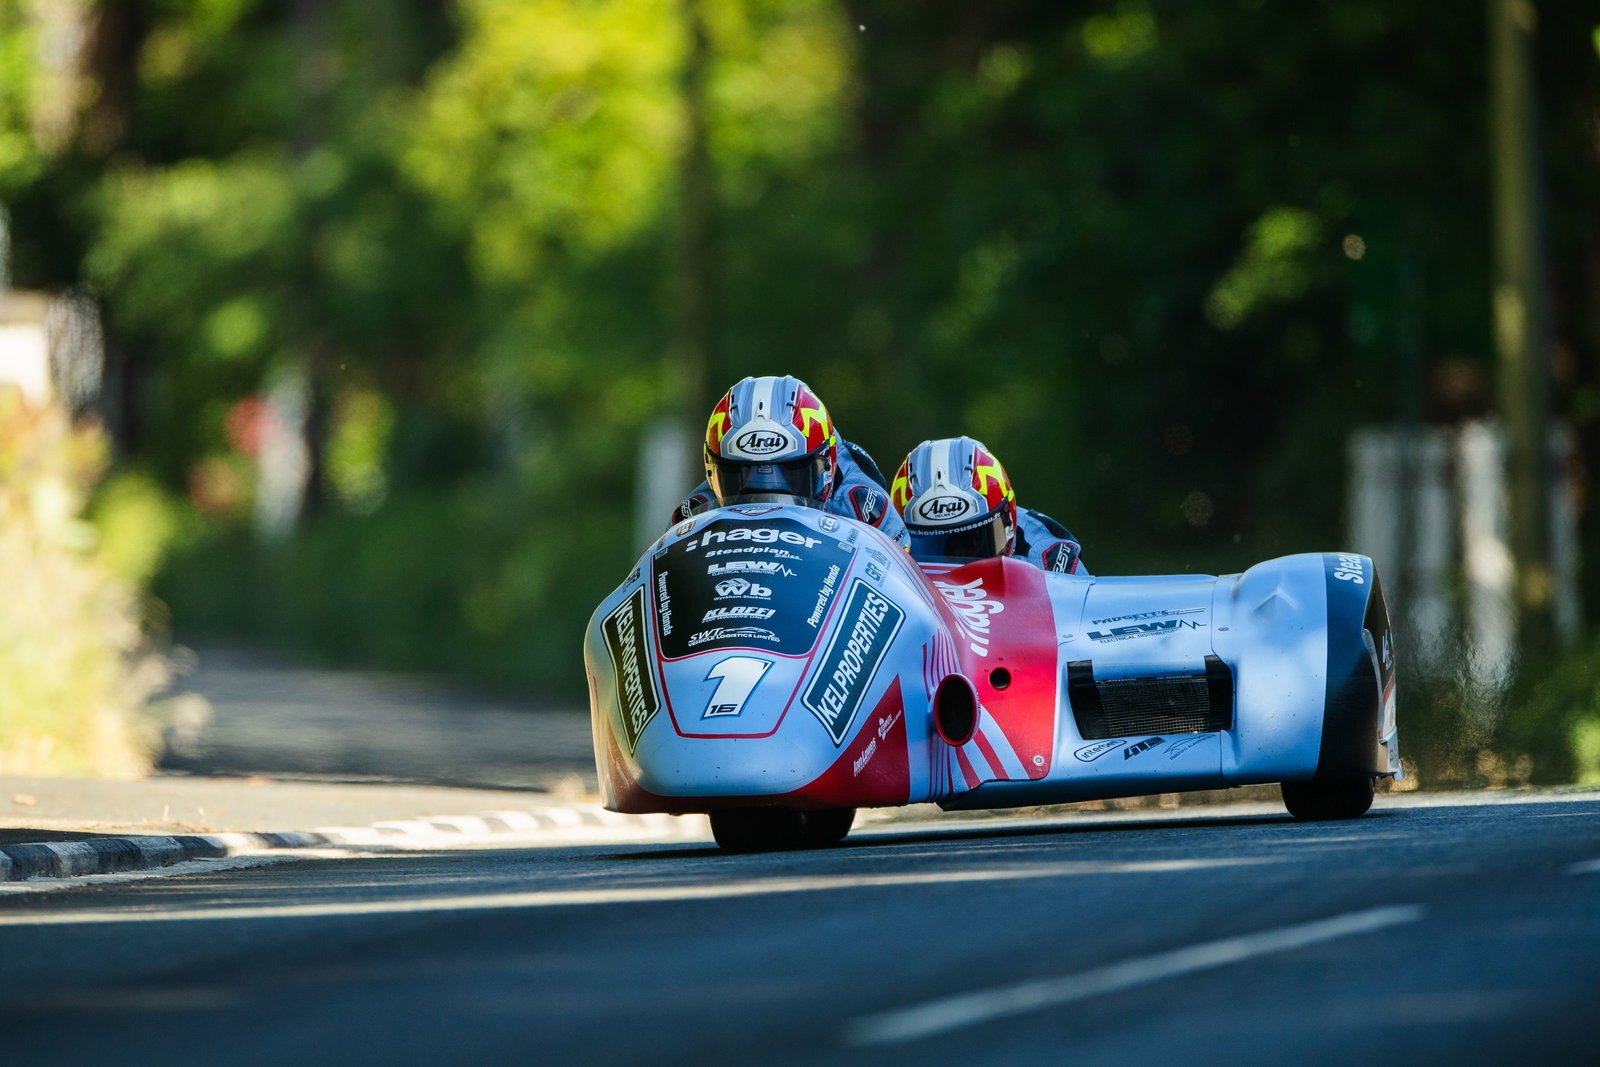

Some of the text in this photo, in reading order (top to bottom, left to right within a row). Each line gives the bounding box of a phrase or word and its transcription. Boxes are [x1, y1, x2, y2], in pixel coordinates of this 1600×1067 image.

[740, 433, 783, 449] Arai
[862, 487, 878, 523] RST
[923, 498, 964, 515] Arai
[705, 546, 790, 558] Steadplan
[707, 560, 780, 575] LEW
[1333, 554, 1365, 585] Stea
[658, 570, 671, 601] Powered
[807, 592, 828, 628] Powered
[823, 564, 840, 588] Honda
[661, 611, 673, 636] Honda
[690, 627, 724, 642] SWT
[1087, 619, 1179, 640] LEW
[688, 635, 718, 647] VEHICLE
[753, 633, 781, 643] LIMITED
[614, 599, 648, 735] KELPROPERTIES
[817, 592, 889, 726] KELPROPERTIES
[703, 656, 775, 719] 1
